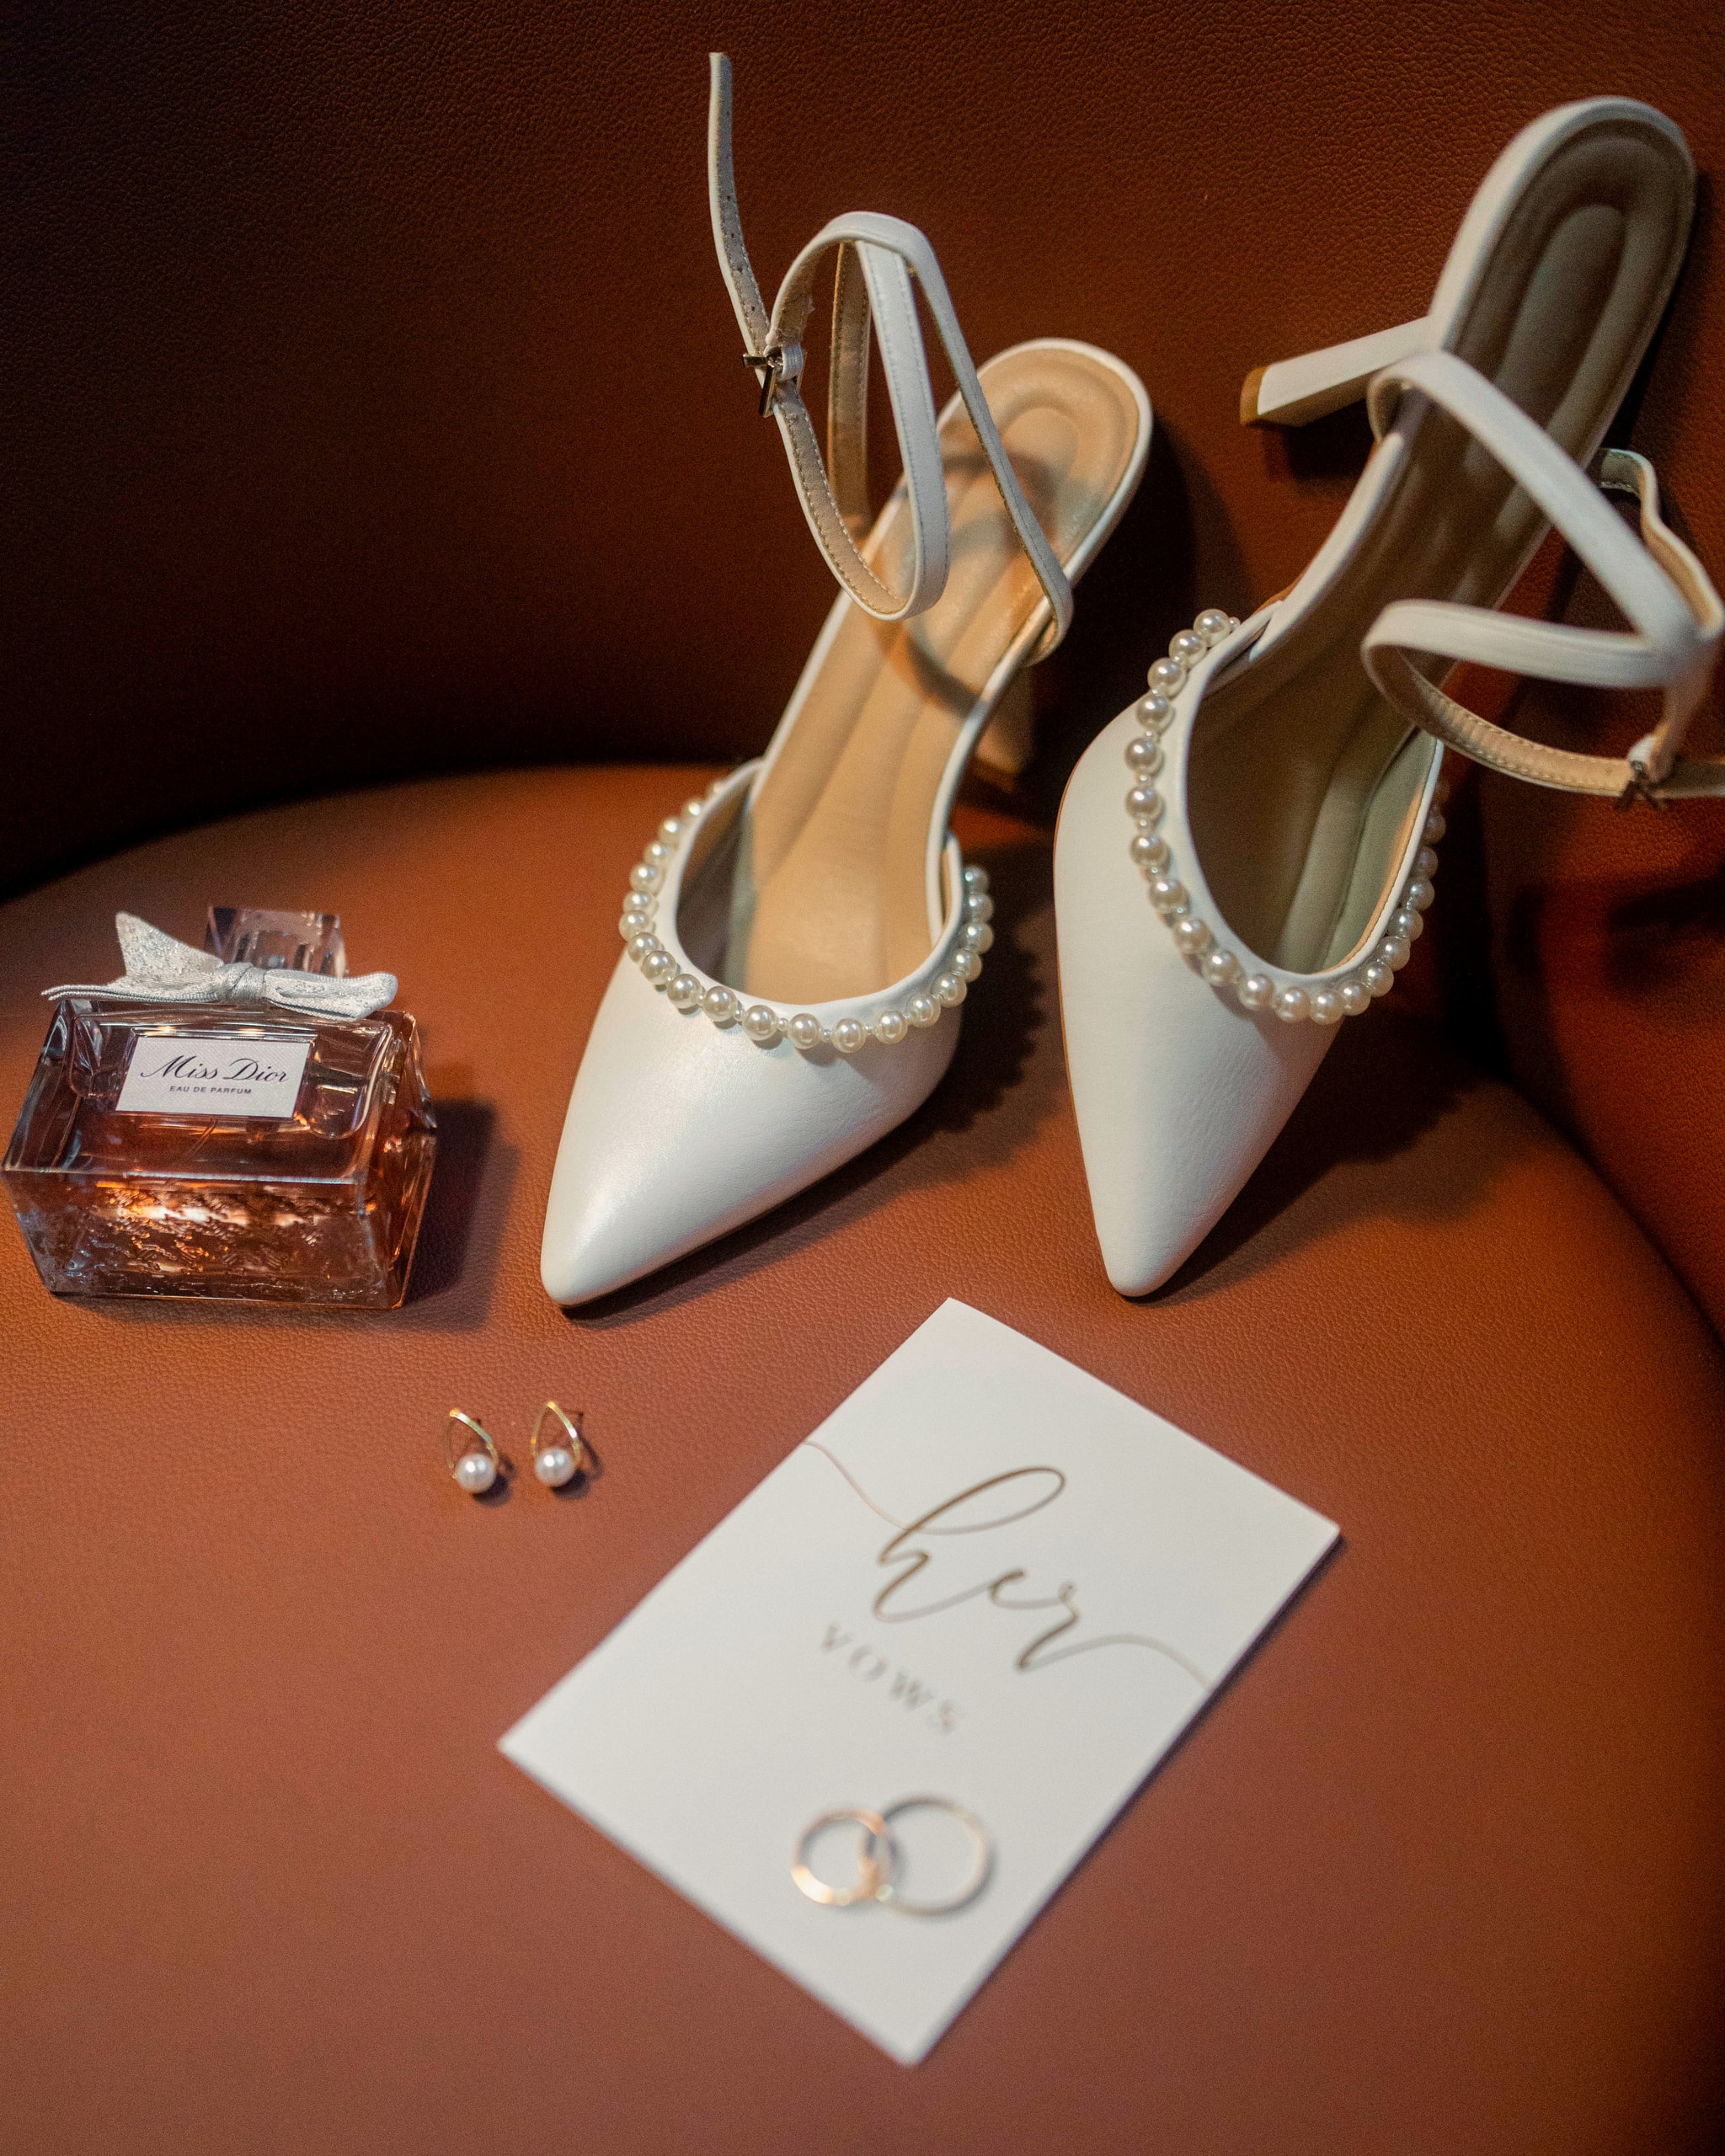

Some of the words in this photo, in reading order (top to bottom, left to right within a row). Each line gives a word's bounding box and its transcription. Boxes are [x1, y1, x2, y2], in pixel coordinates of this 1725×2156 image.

[140, 1054, 219, 1080] Miss
[222, 1058, 289, 1082] Dior
[211, 1086, 252, 1095] PARFUM
[871, 1464, 1129, 1676] her
[820, 1622, 967, 1735] VOWS
